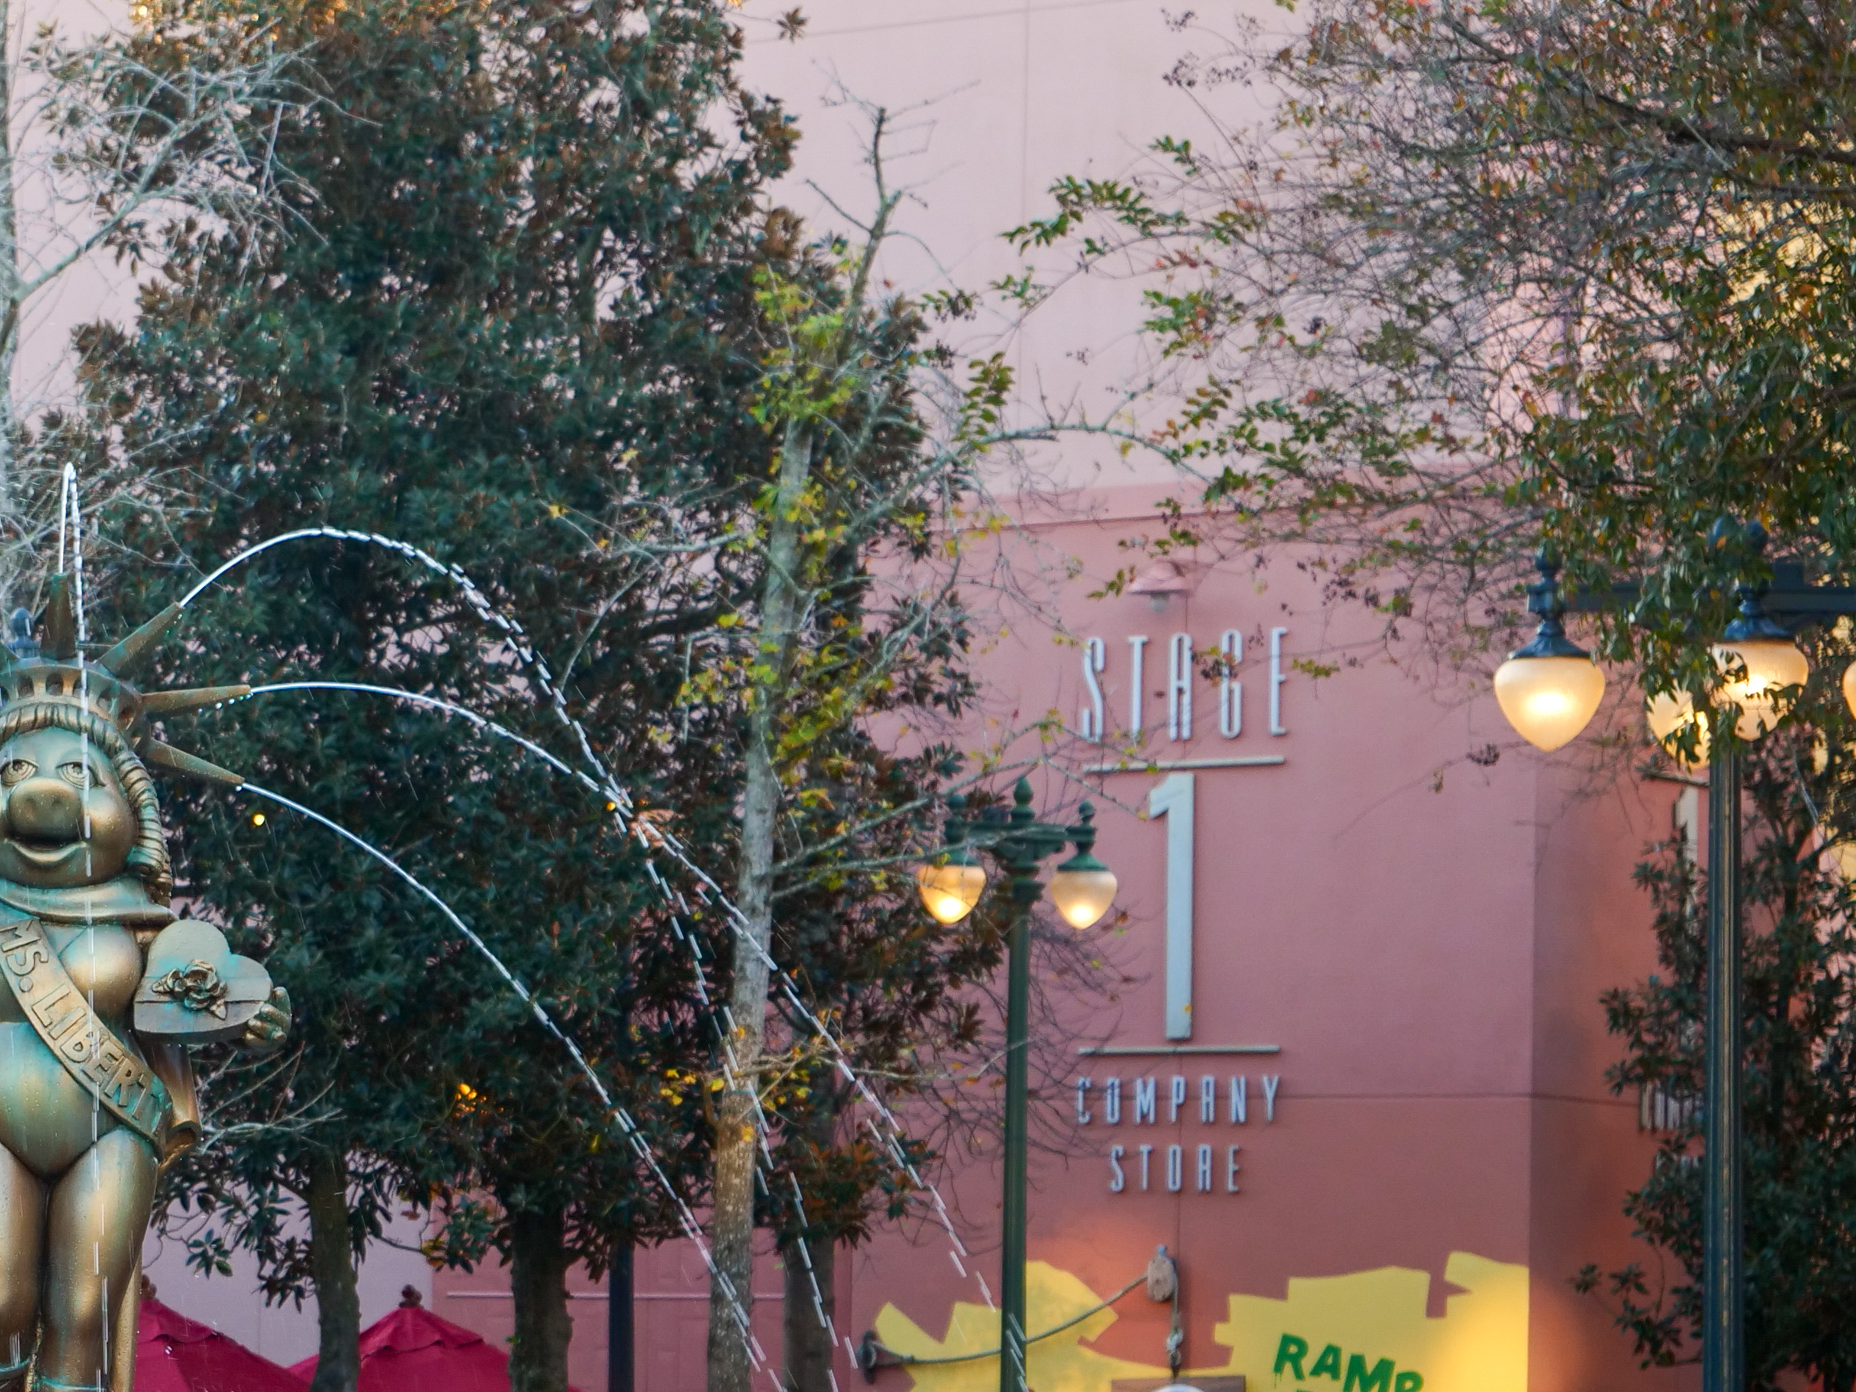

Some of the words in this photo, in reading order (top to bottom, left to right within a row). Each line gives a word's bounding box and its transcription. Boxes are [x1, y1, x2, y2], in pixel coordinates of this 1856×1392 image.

[1082, 627, 1288, 743] STAGE
[1149, 772, 1194, 1039] 1
[1077, 1074, 1280, 1124] COMPANY
[1110, 1144, 1240, 1193] STORE
